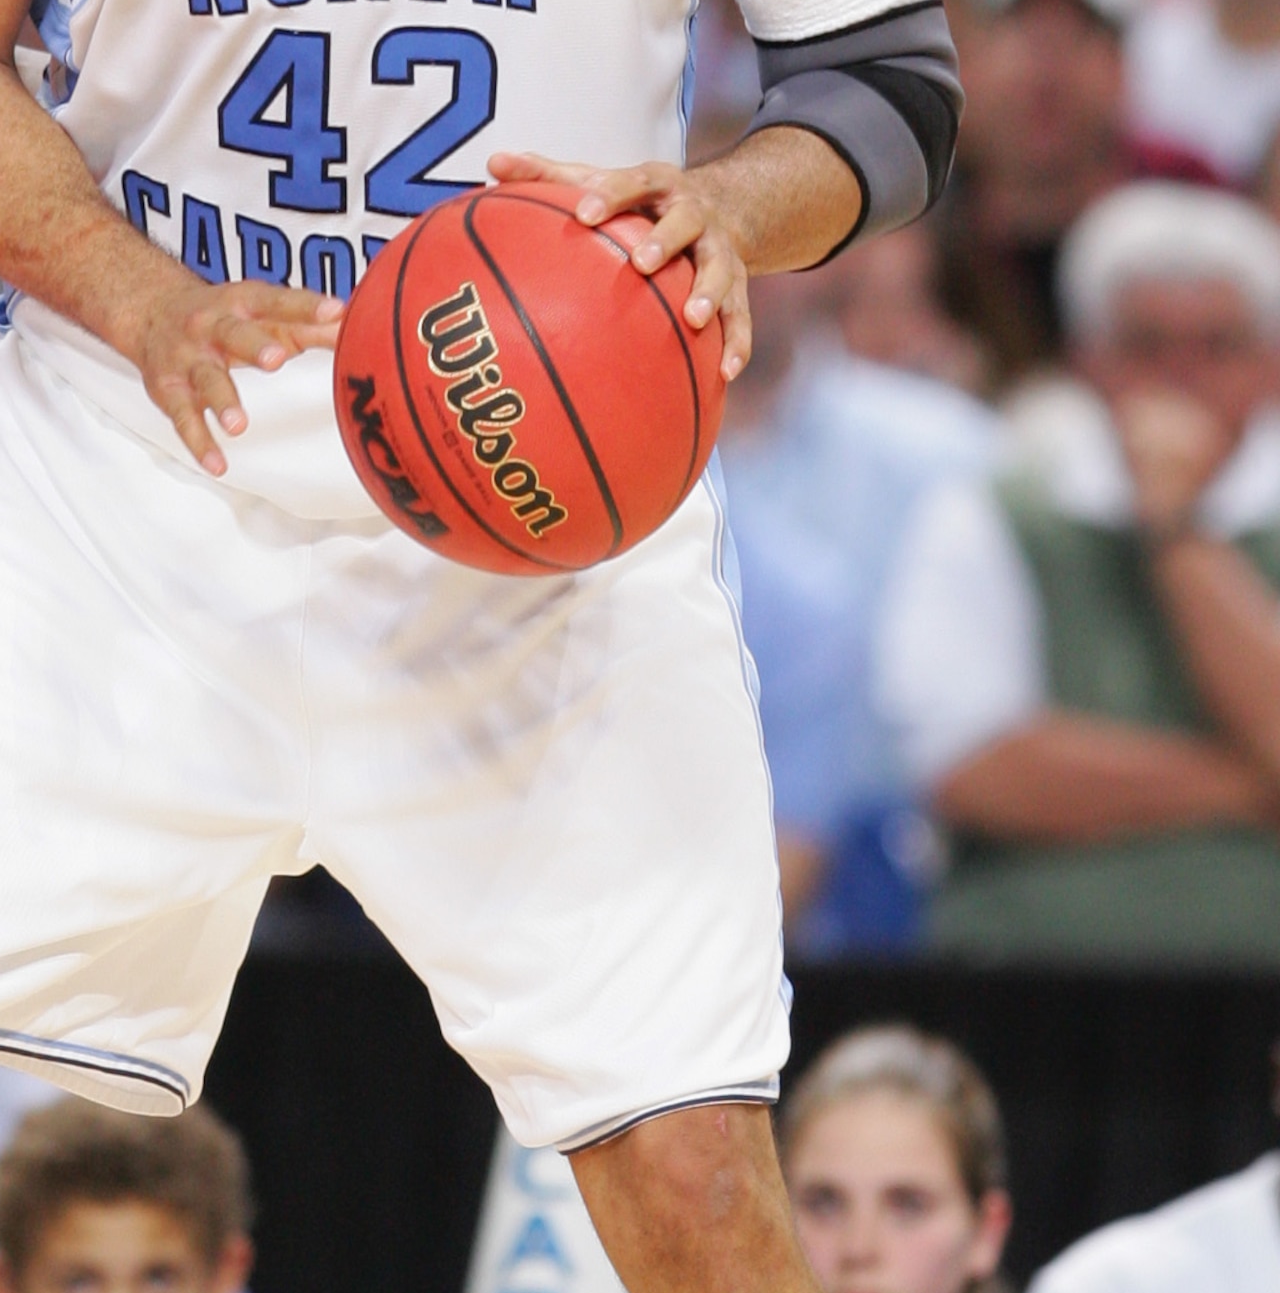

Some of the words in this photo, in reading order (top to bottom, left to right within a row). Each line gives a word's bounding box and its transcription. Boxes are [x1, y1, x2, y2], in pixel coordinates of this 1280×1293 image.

[217, 25, 498, 219] 42
[122, 169, 392, 303] CARO
[347, 373, 451, 539] NCAA
[418, 281, 568, 539] Wilson
